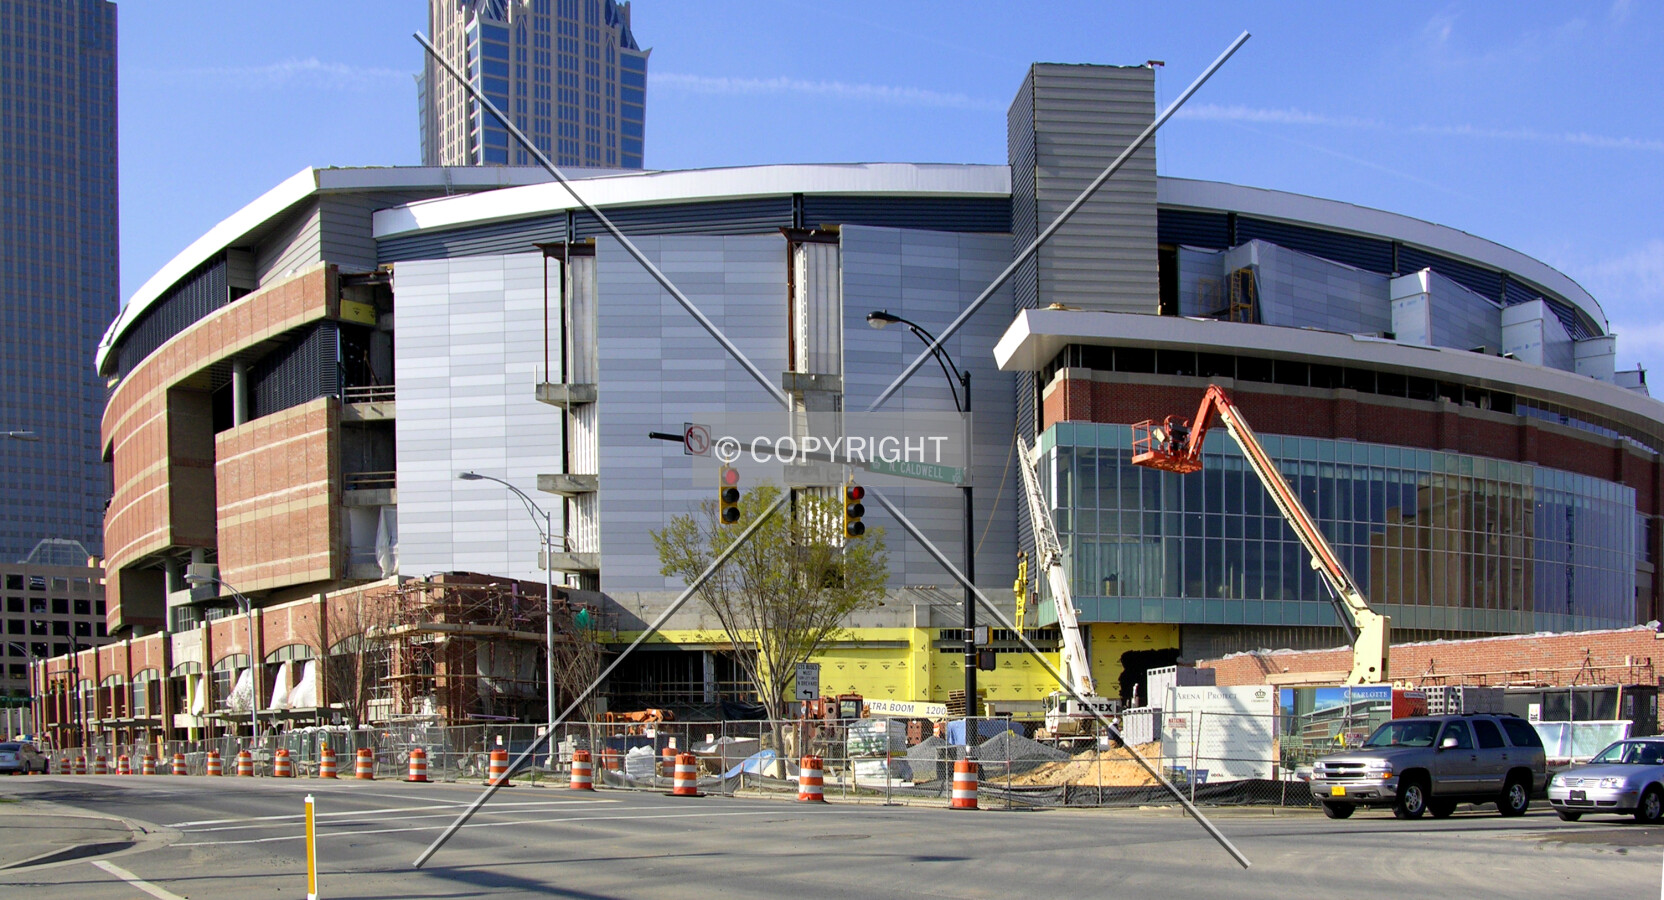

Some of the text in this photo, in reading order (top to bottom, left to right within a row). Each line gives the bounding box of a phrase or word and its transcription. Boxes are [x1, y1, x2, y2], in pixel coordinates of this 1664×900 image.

[900, 462, 943, 479] CALDWELL
[1207, 691, 1237, 700] PROJECT
[1344, 690, 1387, 698] CHARLOTTE
[889, 703, 914, 713] BOOM
[925, 706, 946, 715] 1200
